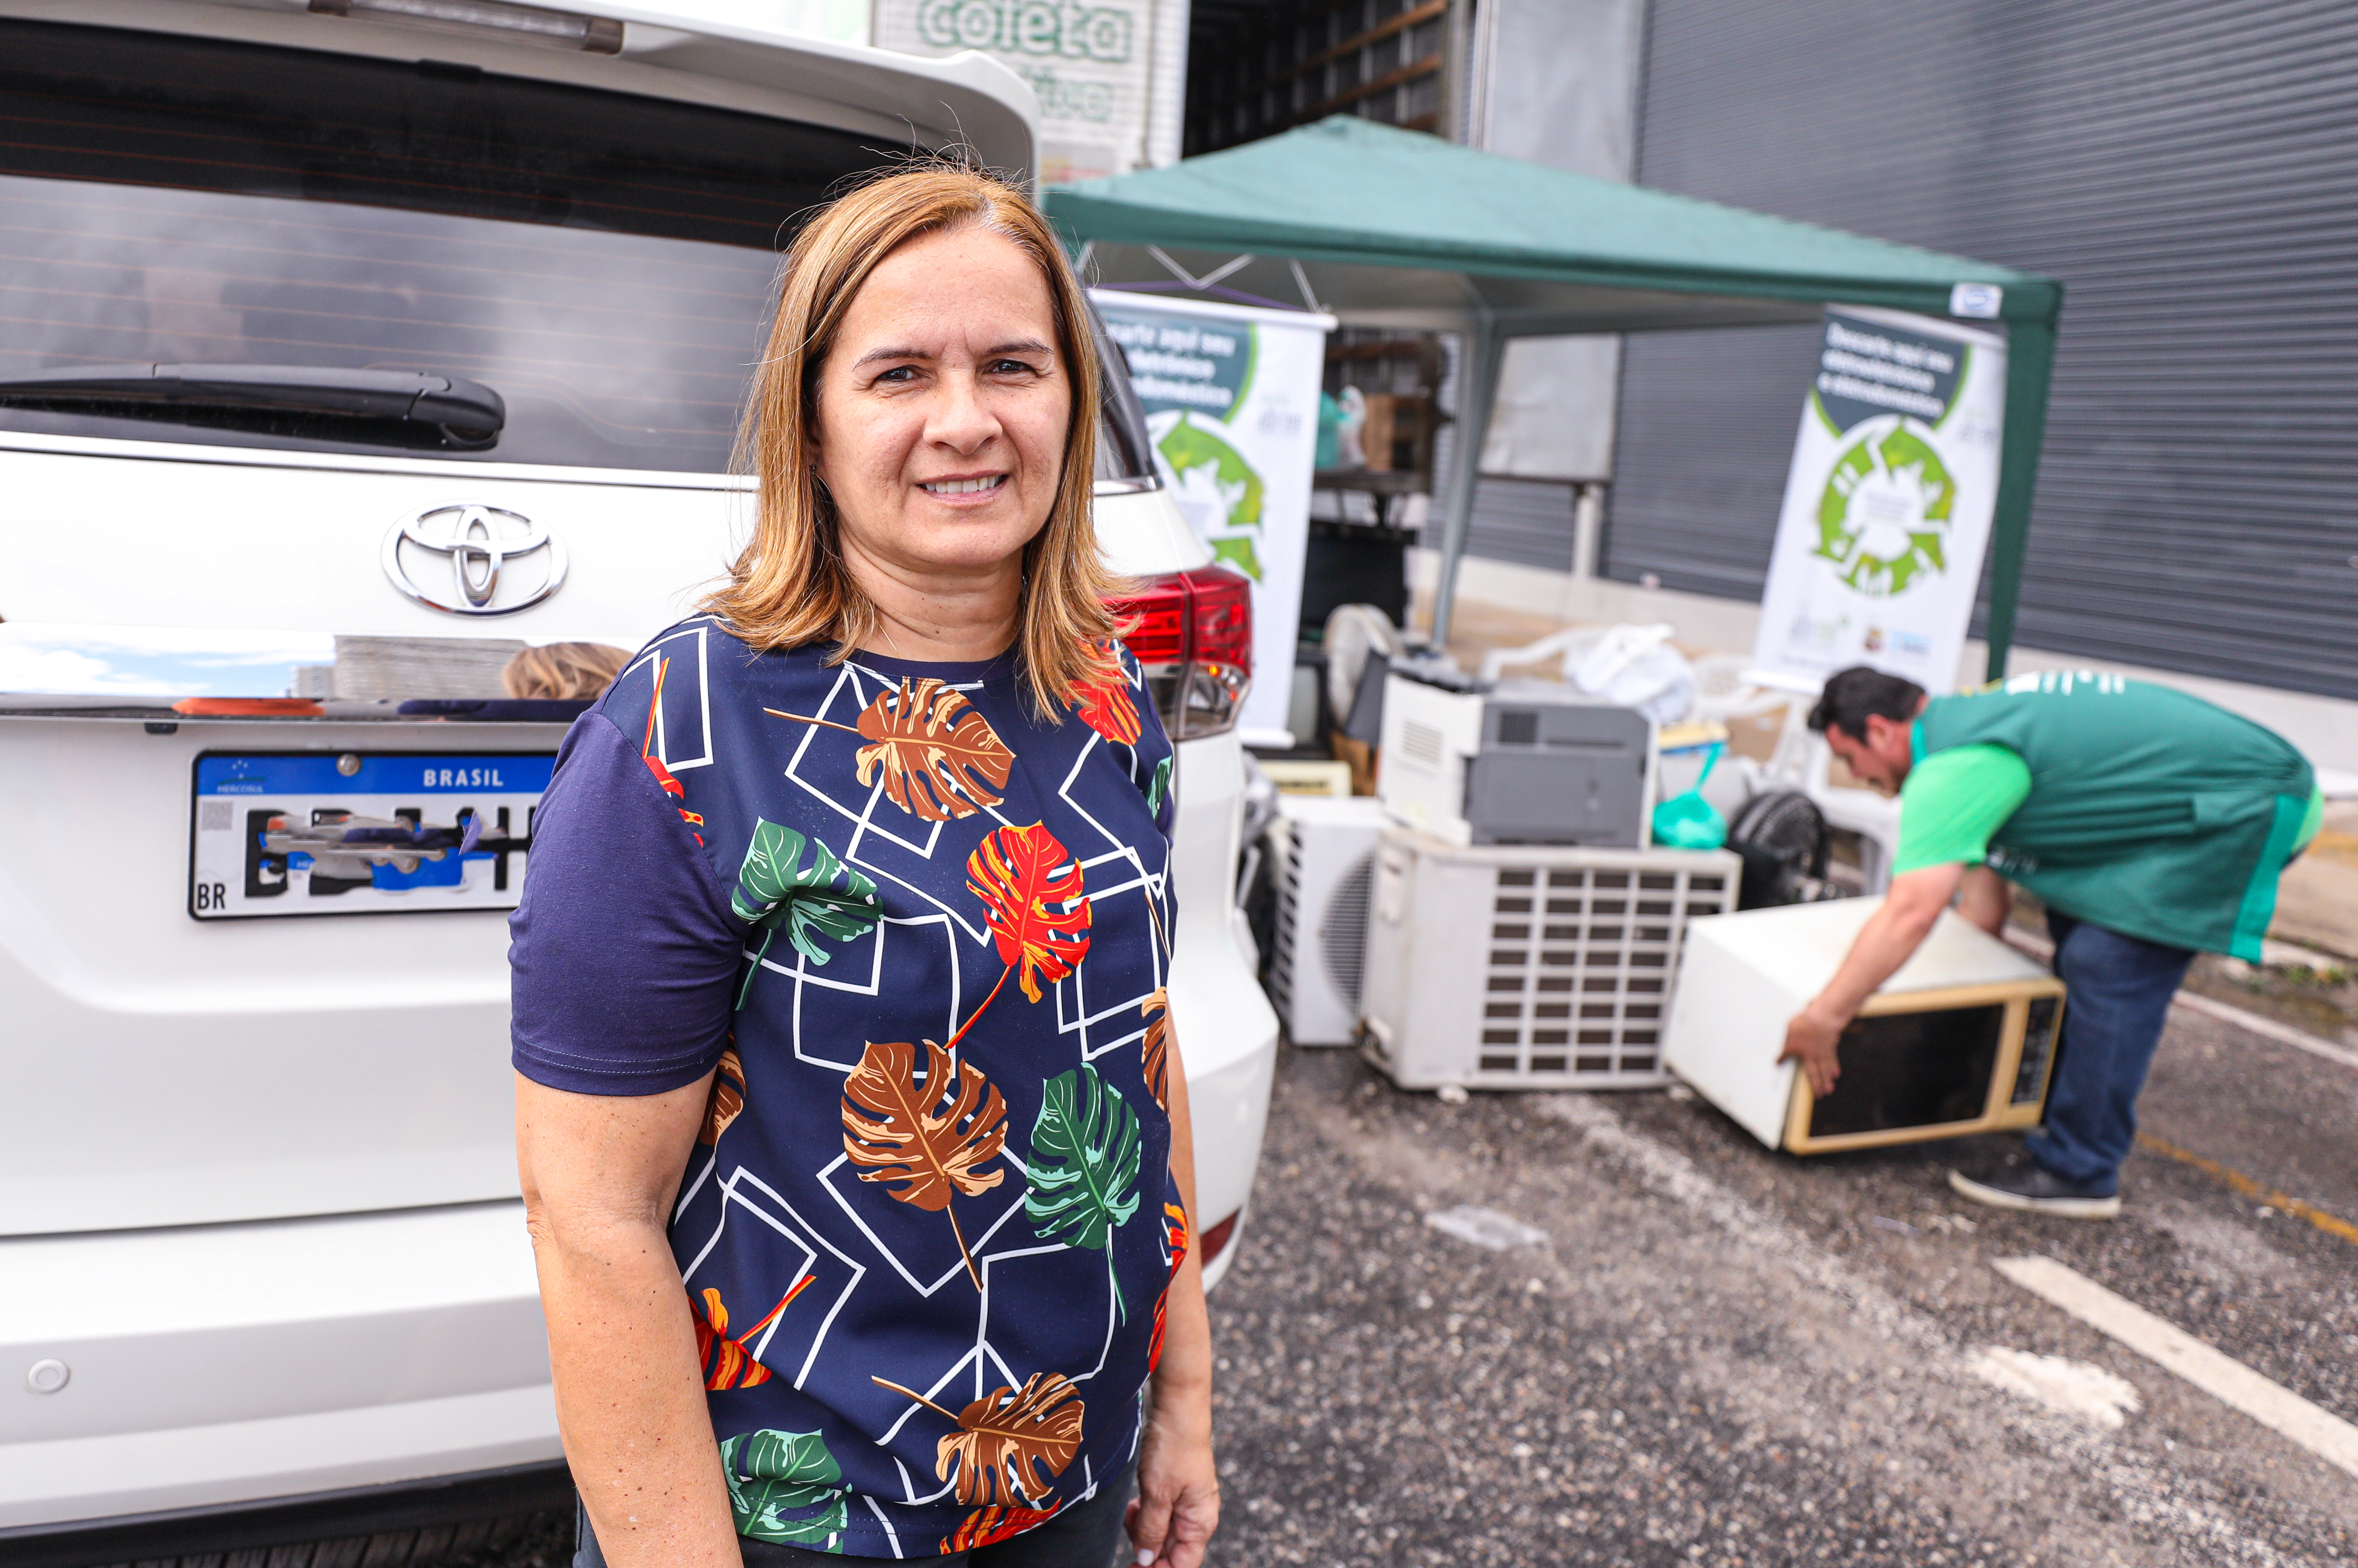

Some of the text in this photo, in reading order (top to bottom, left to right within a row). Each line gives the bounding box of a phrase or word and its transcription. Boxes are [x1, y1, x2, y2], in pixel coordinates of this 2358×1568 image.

[917, 0, 1131, 63] coleta
[1201, 333, 1236, 357] seu
[424, 768, 503, 787] BRASIL
[198, 883, 225, 909] BR
